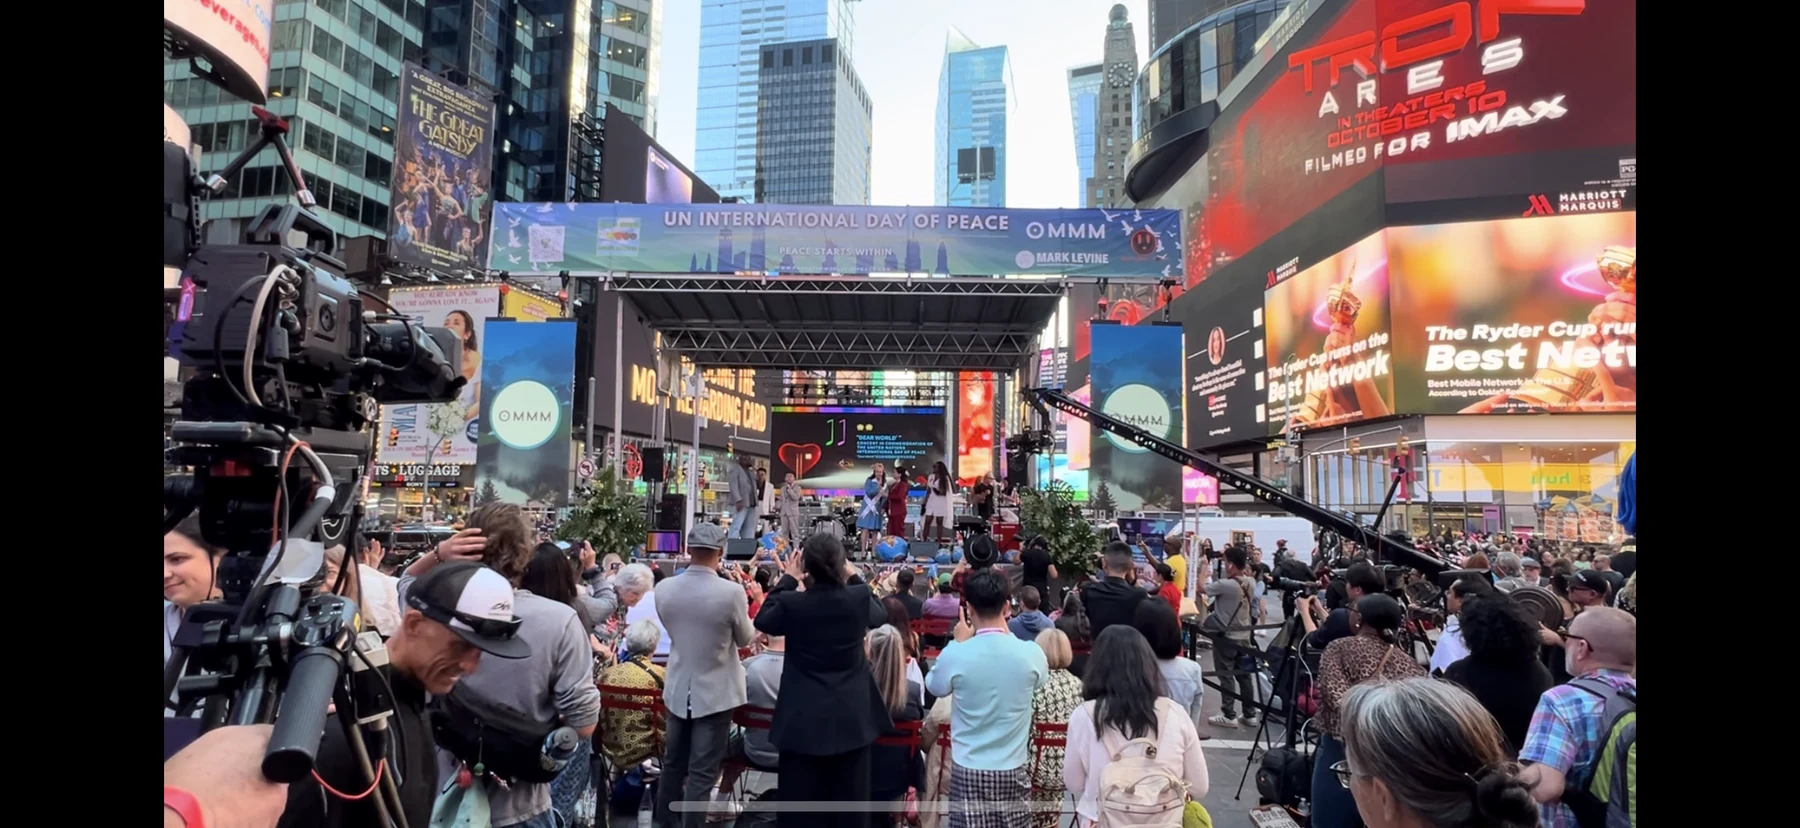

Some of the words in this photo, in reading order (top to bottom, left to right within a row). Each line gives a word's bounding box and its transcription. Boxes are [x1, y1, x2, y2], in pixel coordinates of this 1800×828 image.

[1338, 115, 1351, 129] IN
[1354, 80, 1487, 123] THEATERS
[410, 93, 438, 123] THE
[440, 111, 485, 144] GREAT
[1327, 103, 1456, 149] OCTOBER
[1467, 90, 1507, 114] 10
[418, 120, 478, 155] GATSBY
[1304, 147, 1367, 175] FILMED
[1374, 131, 1431, 160] FOR
[1446, 94, 1568, 144] IMAX
[1559, 189, 1627, 202] MARRIOTT
[1560, 200, 1619, 212] MARQUIS
[664, 211, 692, 227] UN
[700, 211, 858, 228] INTERNATIONAL
[866, 213, 907, 229] DAY
[914, 214, 940, 229] OF
[947, 215, 1009, 231] PEACE
[780, 246, 811, 255] PEACE
[814, 247, 853, 256] STARTS
[855, 248, 892, 256] WITHIN
[1036, 252, 1069, 263] MARK
[1071, 252, 1109, 264] LEVINE
[1276, 256, 1299, 274] MARRIOTT
[1425, 326, 1468, 340] The
[1472, 323, 1544, 342] Ryder
[1548, 321, 1597, 338] Cup
[1268, 366, 1283, 380] The
[1309, 353, 1328, 367] Cup
[1328, 345, 1352, 360] runs
[1352, 339, 1367, 354] on
[1367, 332, 1389, 348] the
[1425, 342, 1528, 372] Best
[1268, 373, 1303, 404] Best
[1304, 349, 1391, 394] Network
[1427, 379, 1448, 388] Best
[1450, 379, 1482, 388] Mobile
[1483, 378, 1521, 387] Network
[1428, 389, 1467, 398] According
[499, 410, 552, 422] OMMM
[743, 399, 767, 433] CARD
[400, 465, 460, 476] LUGGAGE
